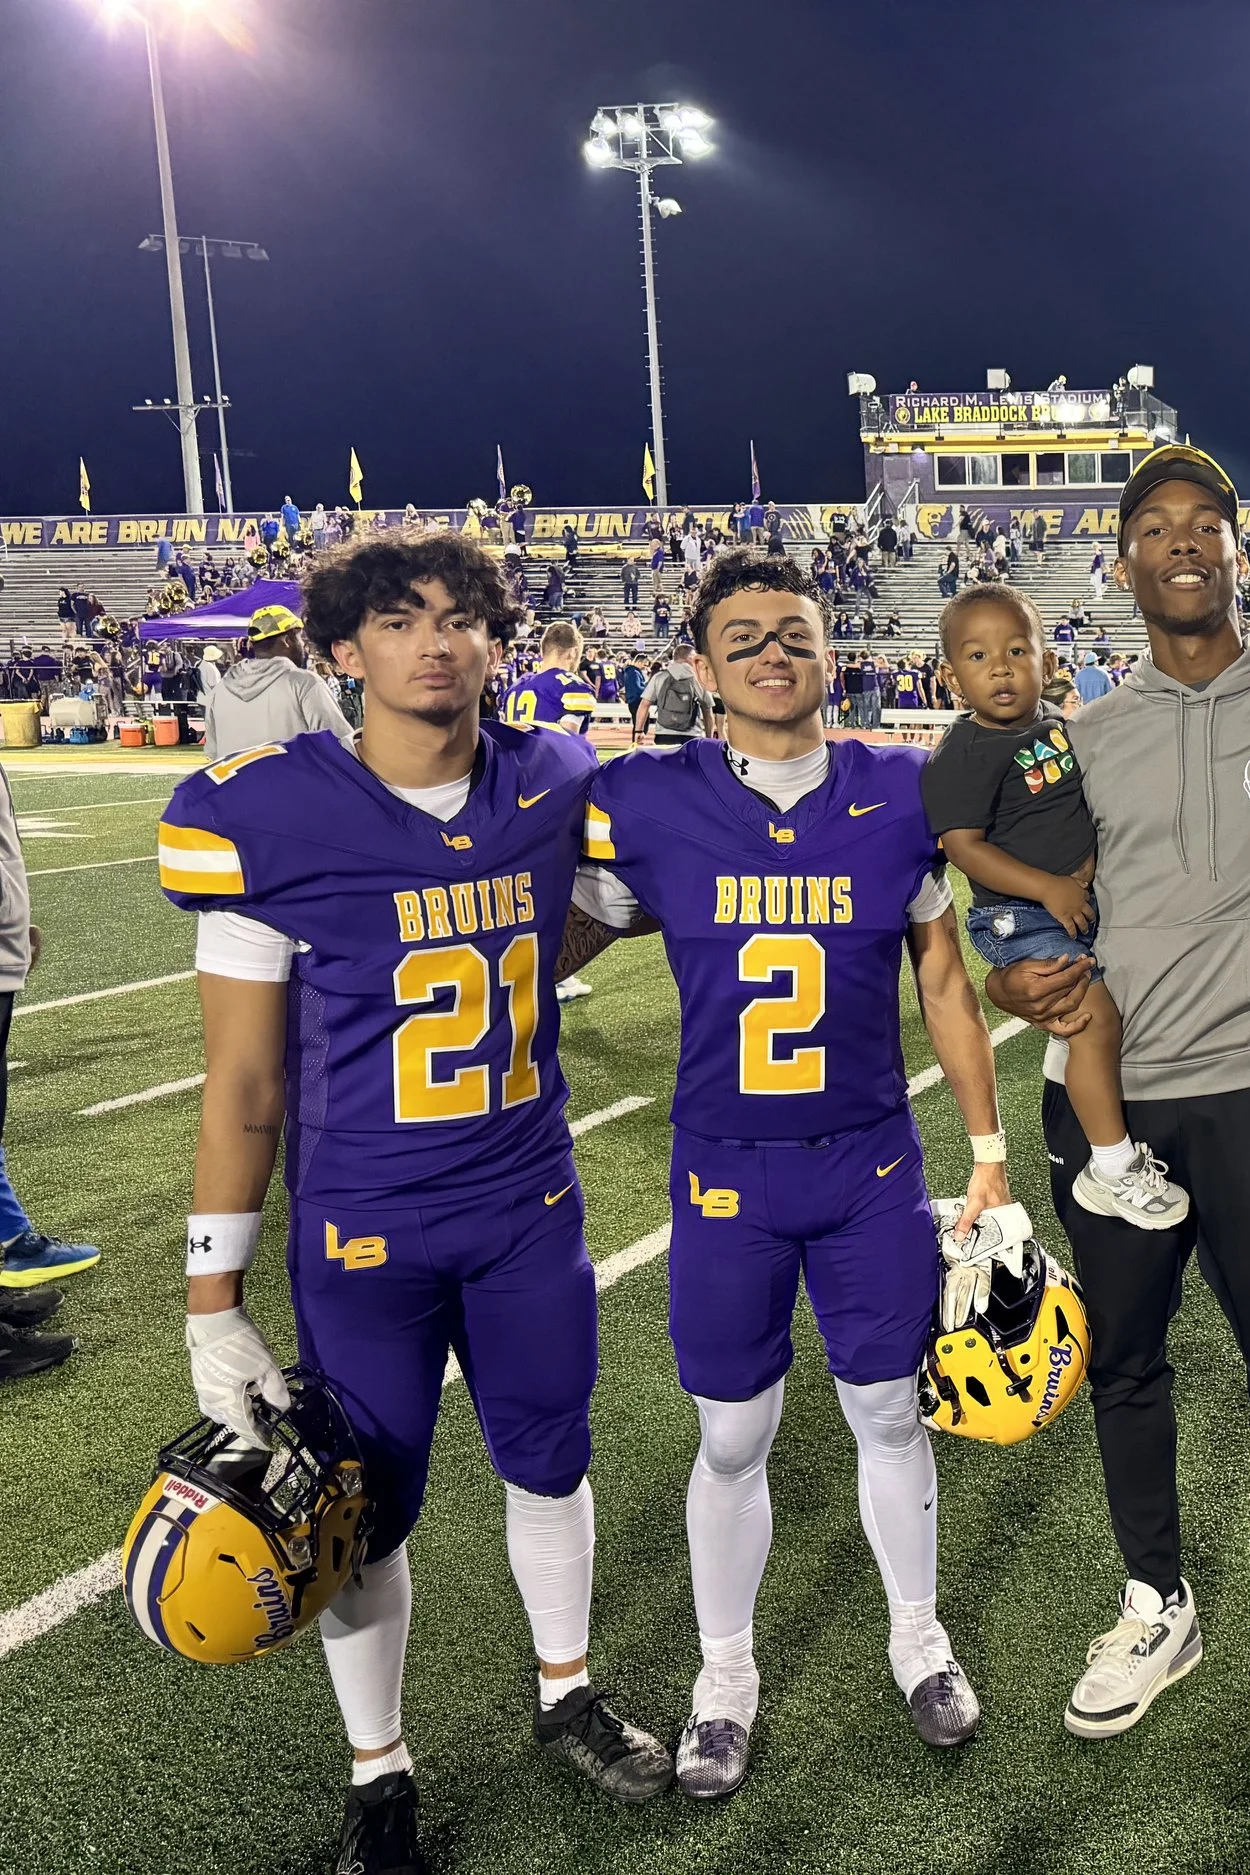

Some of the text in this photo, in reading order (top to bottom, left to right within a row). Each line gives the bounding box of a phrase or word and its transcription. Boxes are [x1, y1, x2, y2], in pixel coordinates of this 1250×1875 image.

[895, 395, 959, 407] RICHARD
[965, 395, 983, 406] M.
[914, 407, 949, 423] LAKE
[953, 406, 1028, 422] BRADDOCK
[1, 522, 42, 545] WE
[50, 521, 109, 544] ARE
[117, 519, 209, 543] BRUIN
[530, 513, 636, 538] BRUIN
[897, 674, 914, 692] 30
[393, 872, 536, 943] BRUINS
[713, 875, 854, 925] BRUINS
[392, 932, 541, 1124] 21
[738, 933, 826, 1095] 2
[1034, 1343, 1074, 1420] Bruins
[164, 1479, 210, 1509] Riddell
[246, 1566, 296, 1650] Bruins
